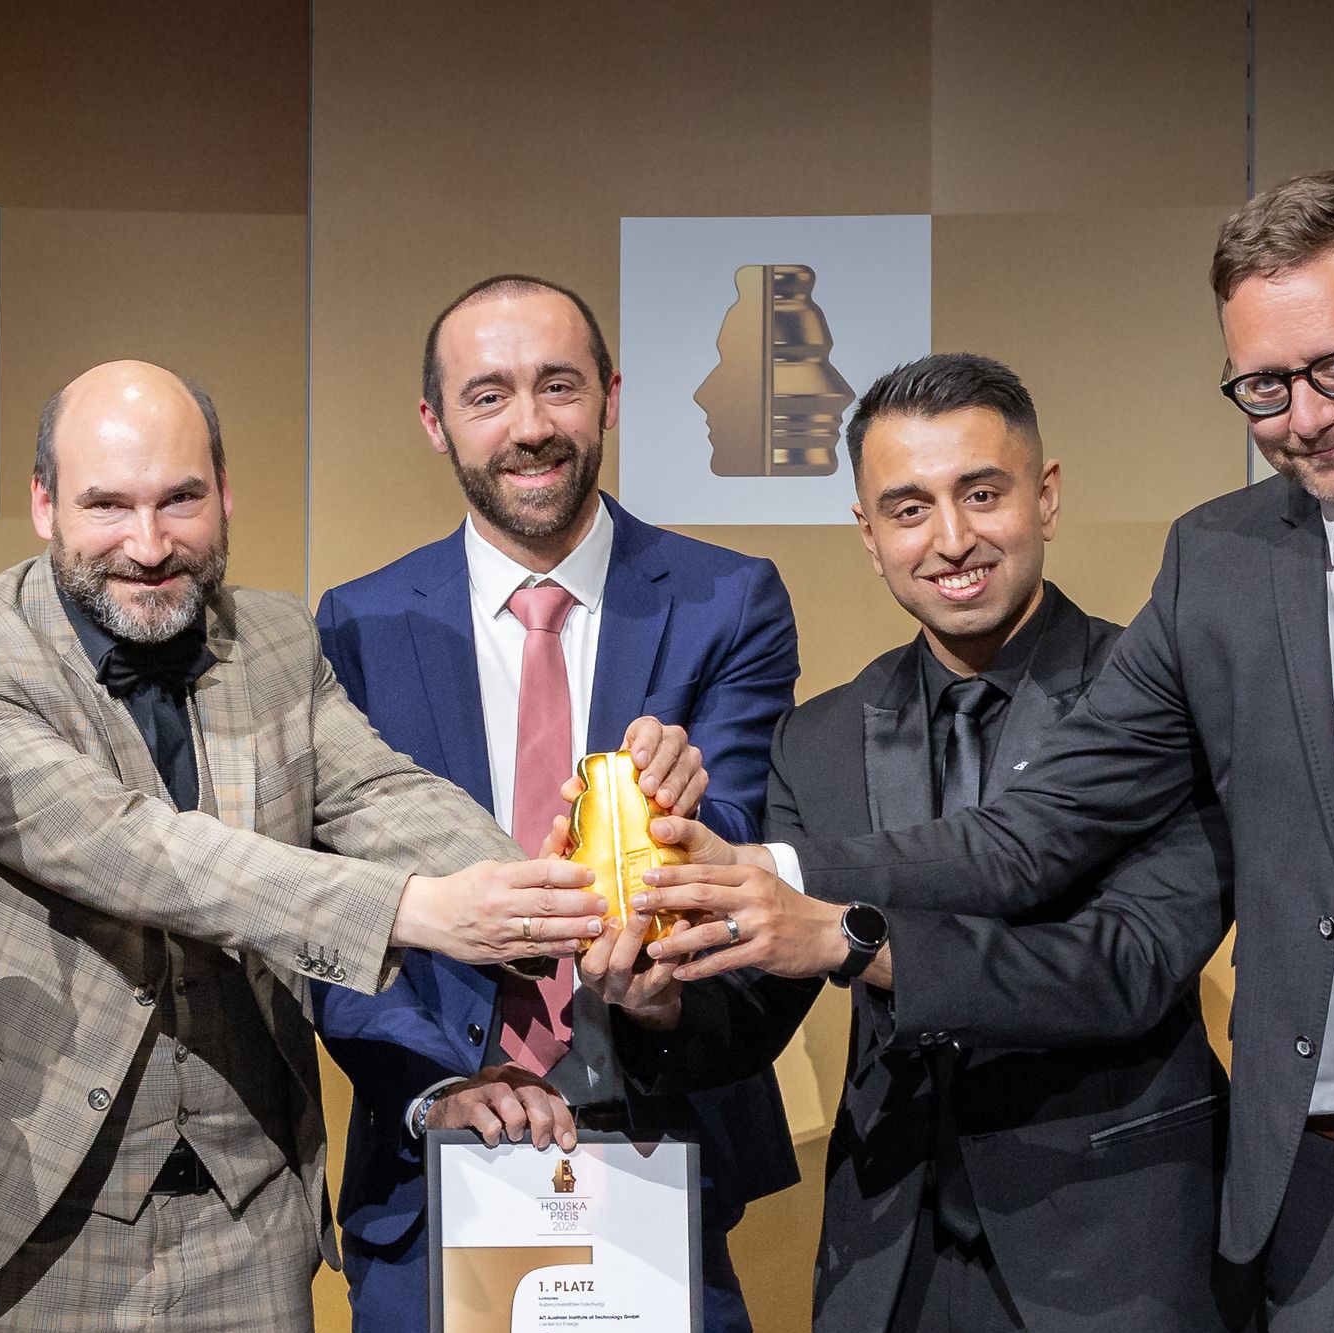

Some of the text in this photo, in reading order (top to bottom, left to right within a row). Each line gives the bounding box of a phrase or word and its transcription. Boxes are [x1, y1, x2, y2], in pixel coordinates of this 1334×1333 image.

[541, 1202, 587, 1211] HOUSKA
[550, 1211, 579, 1221] PREIS
[552, 1221, 577, 1231] 2026
[538, 1280, 594, 1292] 1. PLATZ
